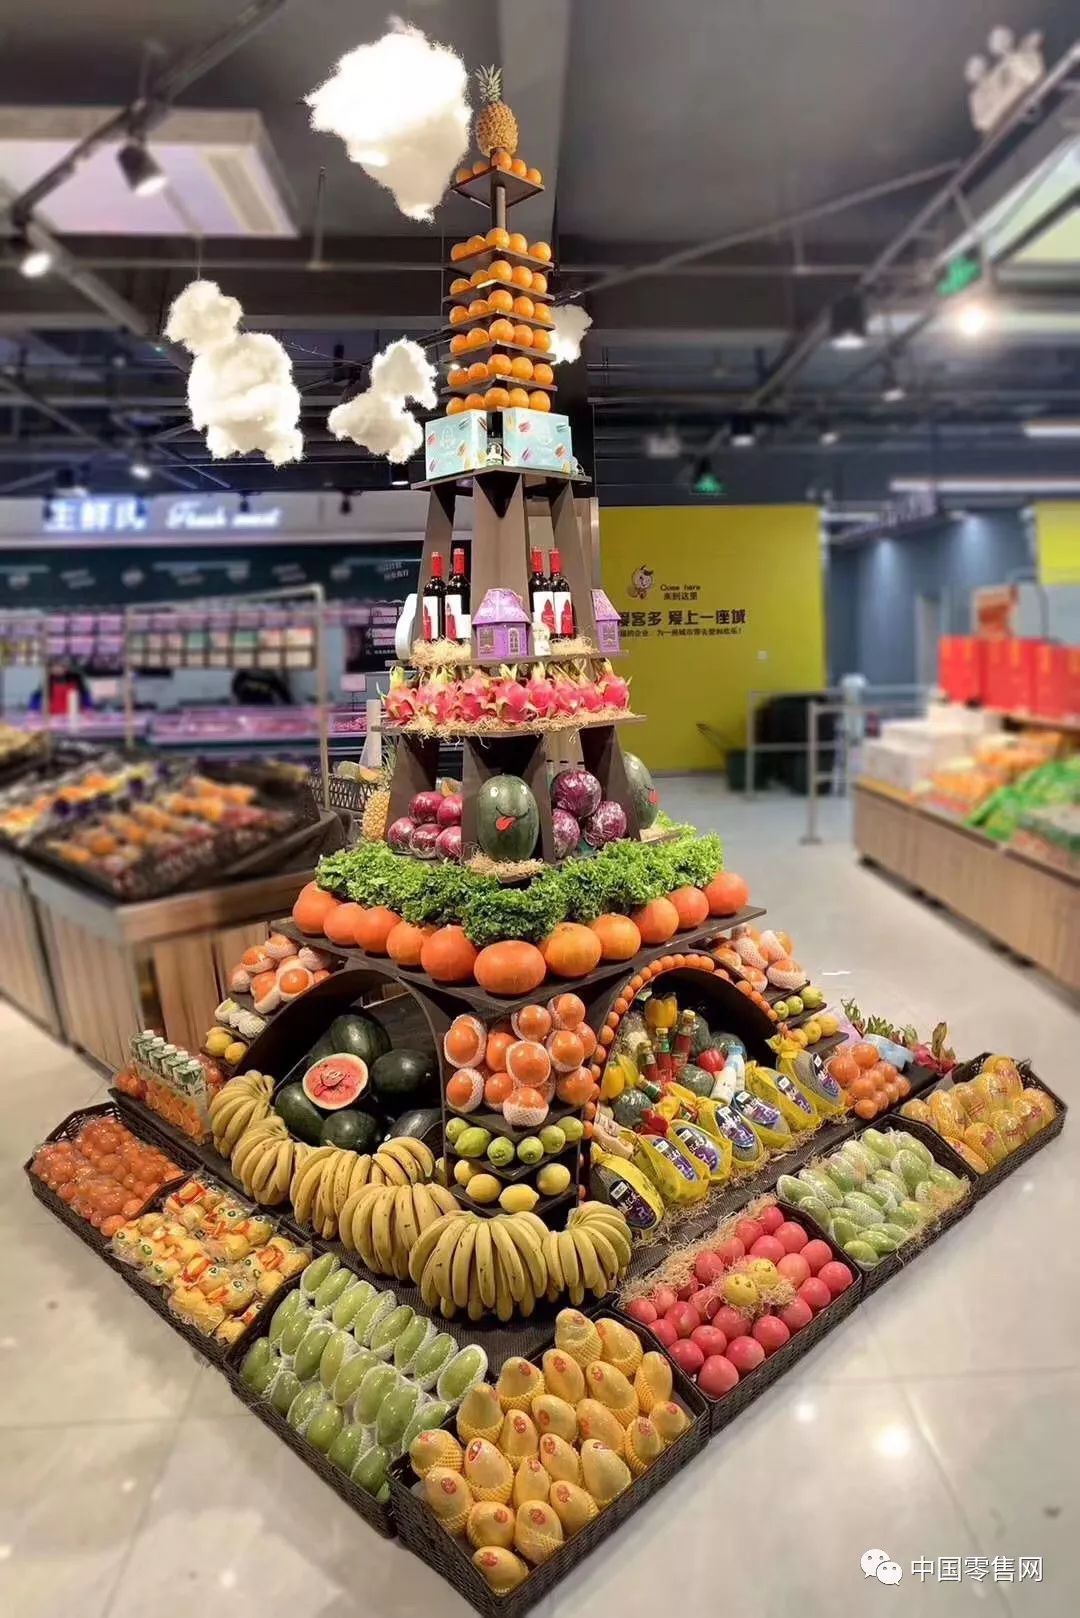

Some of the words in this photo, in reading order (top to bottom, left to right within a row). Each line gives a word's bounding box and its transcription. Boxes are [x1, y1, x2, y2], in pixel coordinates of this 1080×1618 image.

[663, 591, 698, 601] 来到这里
[668, 609, 746, 626] 爱上一座城
